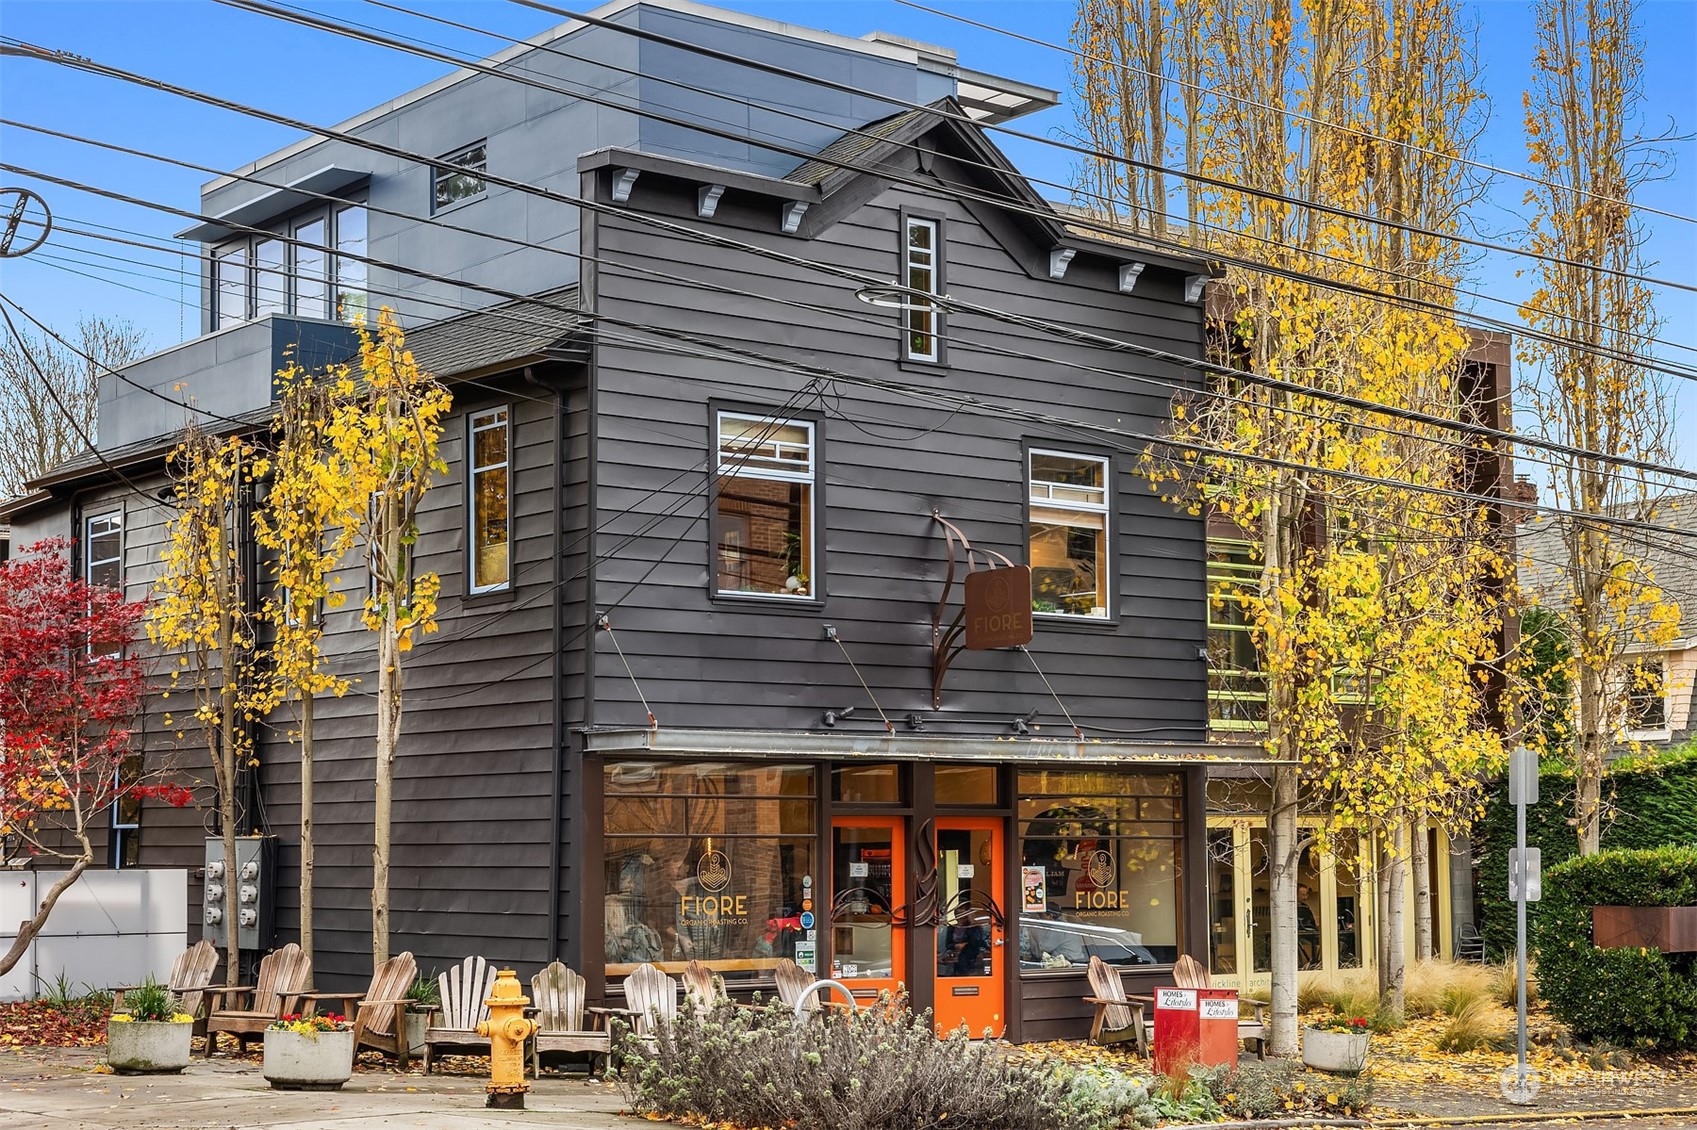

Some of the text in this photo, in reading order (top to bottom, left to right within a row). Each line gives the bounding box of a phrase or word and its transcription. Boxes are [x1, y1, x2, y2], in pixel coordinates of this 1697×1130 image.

[974, 613, 1022, 634] FIORE
[1075, 890, 1129, 909] FIORE
[681, 895, 748, 916] FIORE
[708, 918, 737, 926] ROASTING
[1212, 979, 1241, 988] ickline
[1162, 990, 1183, 998] HOMES
[1164, 997, 1192, 1008] Lifestyles
[1205, 1000, 1226, 1008] HOMES
[1207, 1007, 1234, 1018] Lifestyles
